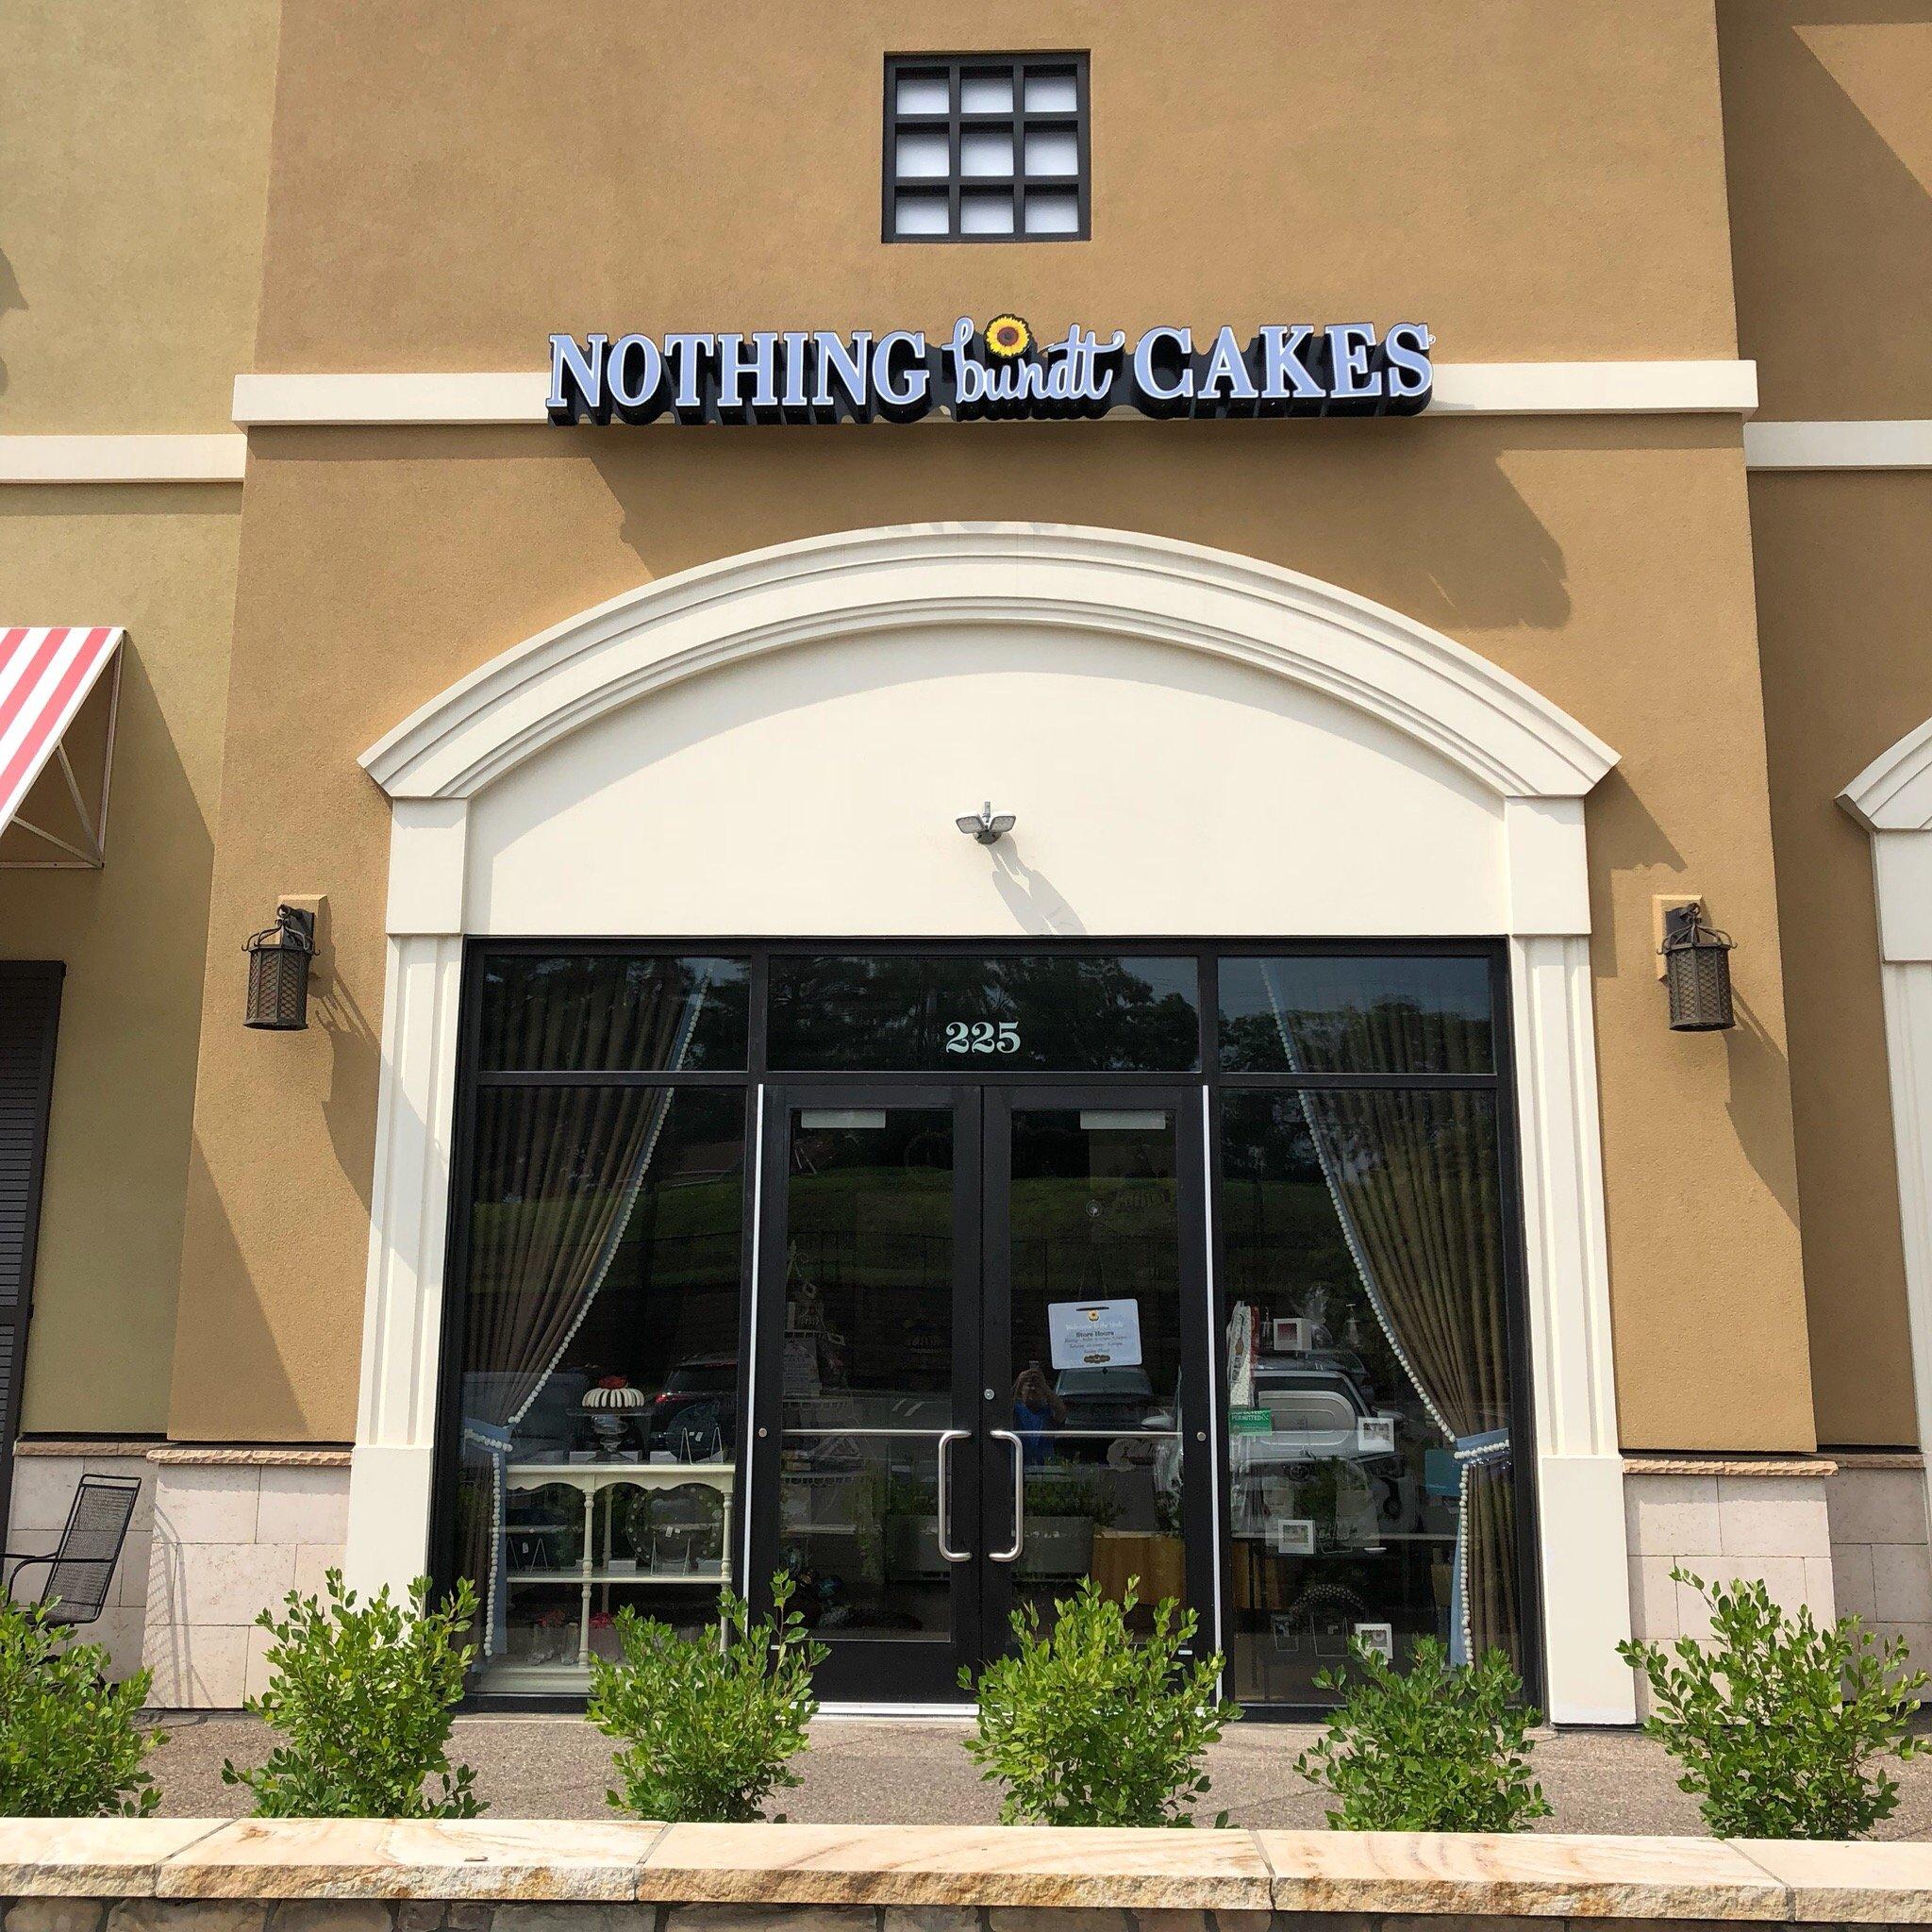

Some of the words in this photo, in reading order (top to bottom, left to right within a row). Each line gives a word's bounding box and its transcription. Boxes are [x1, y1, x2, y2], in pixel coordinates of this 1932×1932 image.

[546, 331, 930, 408] NOTHING
[941, 317, 1126, 405] bundt
[1133, 322, 1435, 402] CAKES
[945, 1022, 1022, 1054] 225
